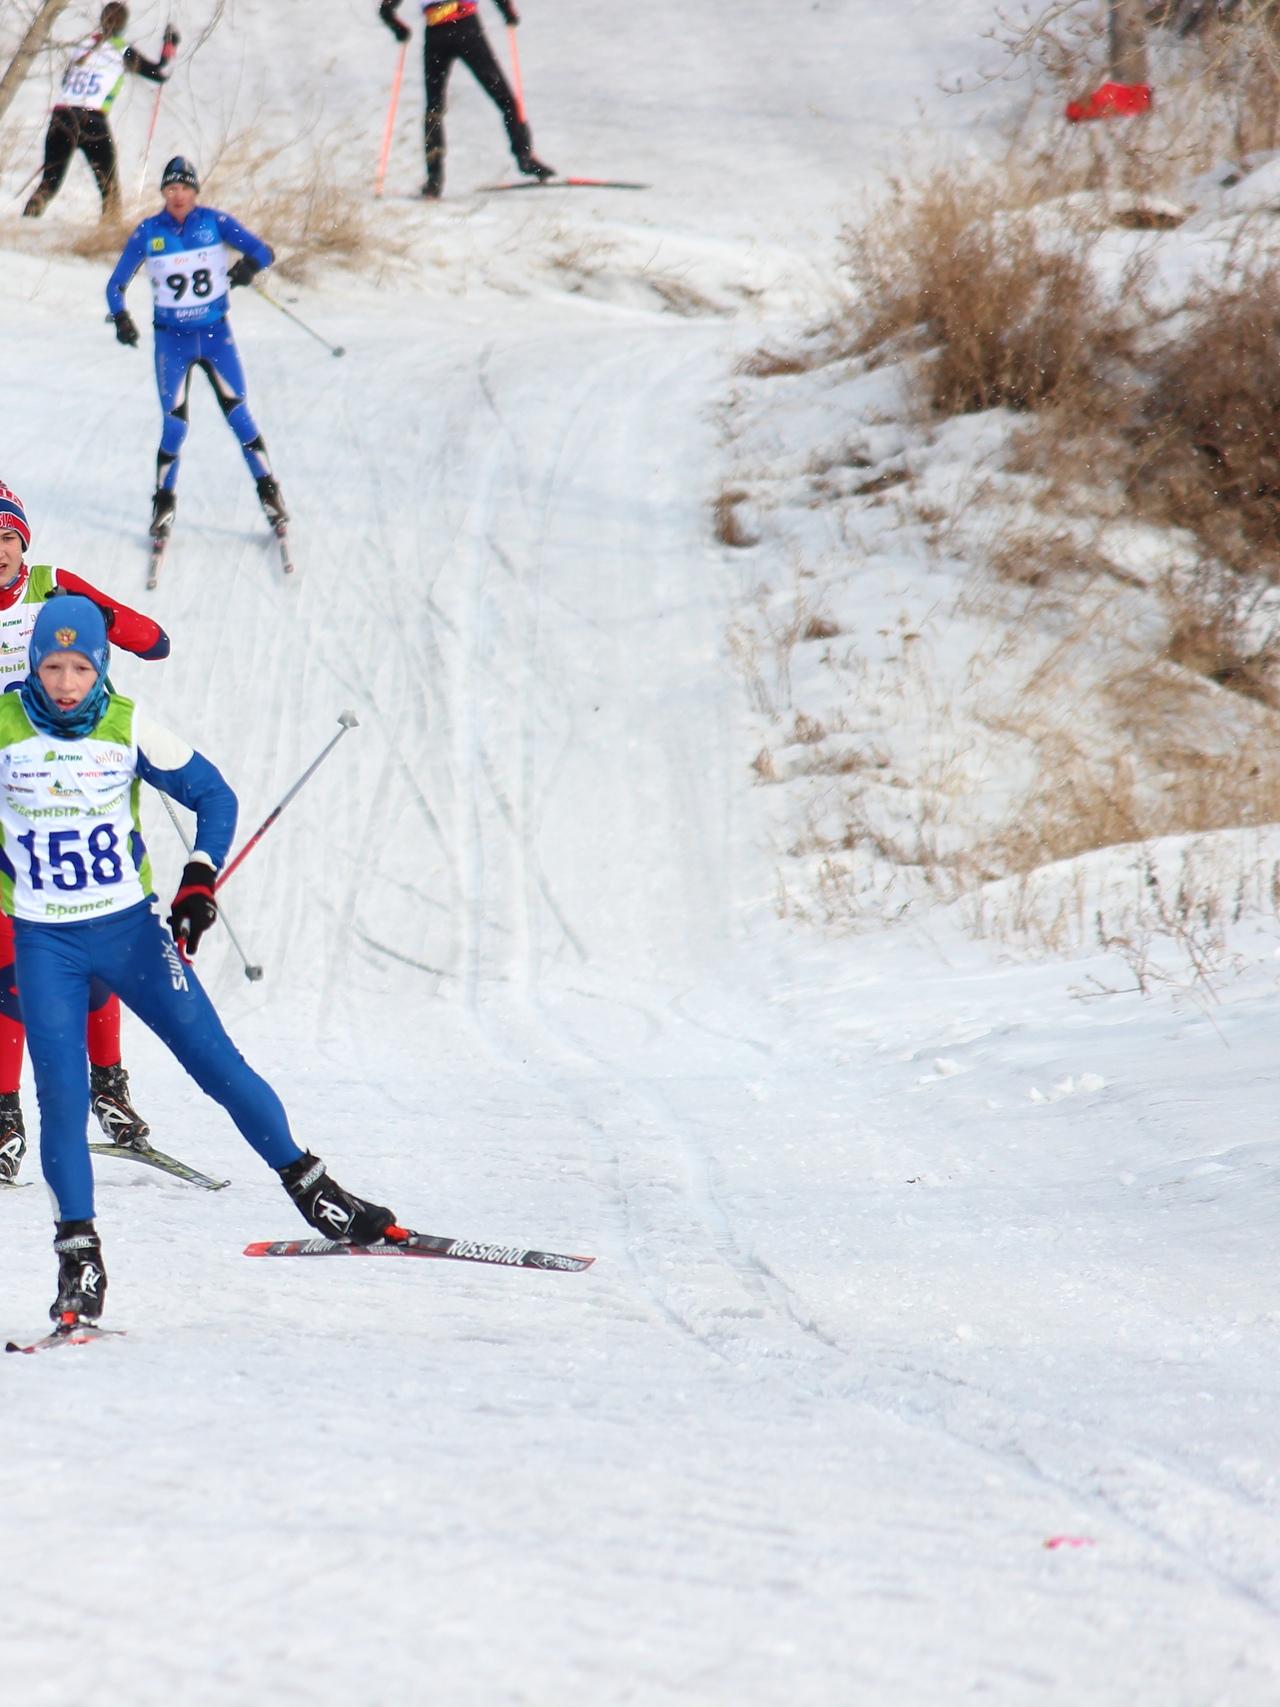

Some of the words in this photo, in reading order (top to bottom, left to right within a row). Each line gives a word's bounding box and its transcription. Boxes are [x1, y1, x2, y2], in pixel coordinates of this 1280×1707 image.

[166, 268, 213, 301] 98
[17, 823, 124, 891] 158
[44, 897, 114, 919] Братск
[446, 1239, 528, 1266] ROSSIGNOL
